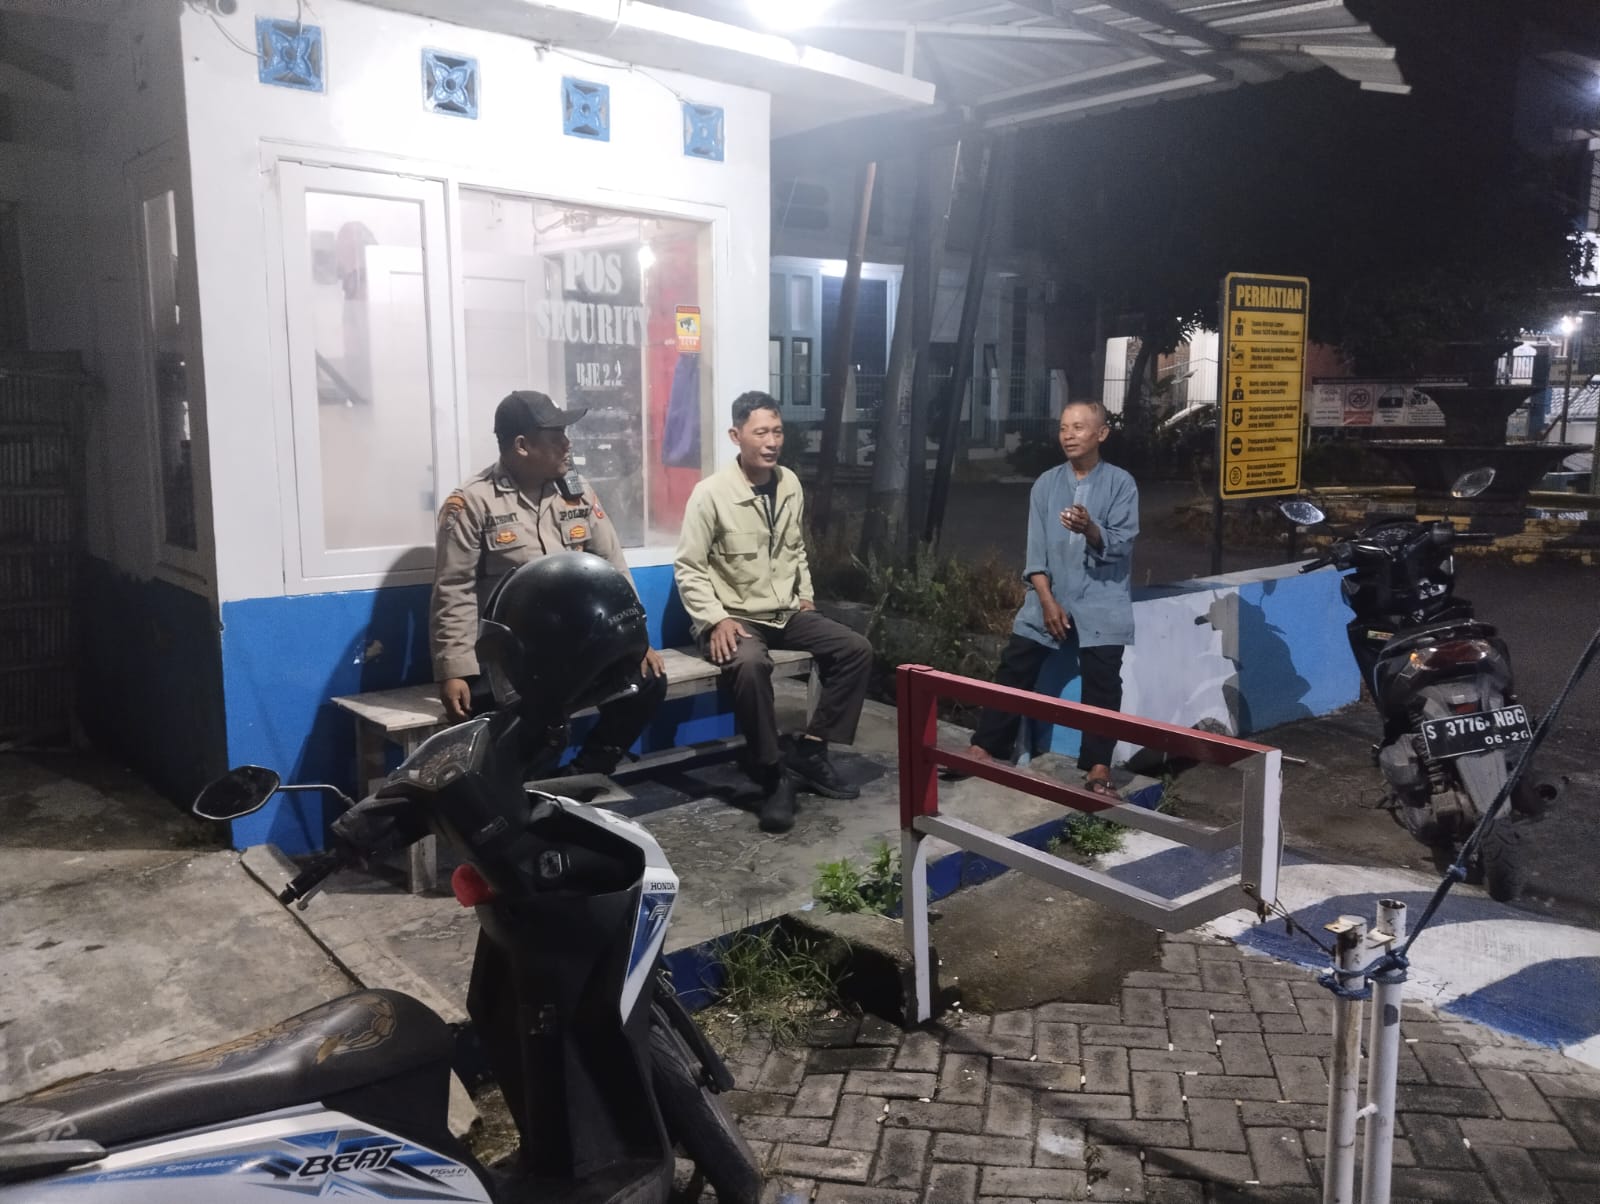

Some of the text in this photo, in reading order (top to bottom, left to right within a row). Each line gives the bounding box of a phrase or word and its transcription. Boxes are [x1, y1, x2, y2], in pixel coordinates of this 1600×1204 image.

[562, 250, 623, 295] POS
[1236, 285, 1303, 309] PERHATIAN
[537, 302, 649, 346] SECURITY
[608, 606, 640, 626] HONDA
[1426, 708, 1525, 739] S 3776 NBG
[650, 882, 676, 891] HONDA
